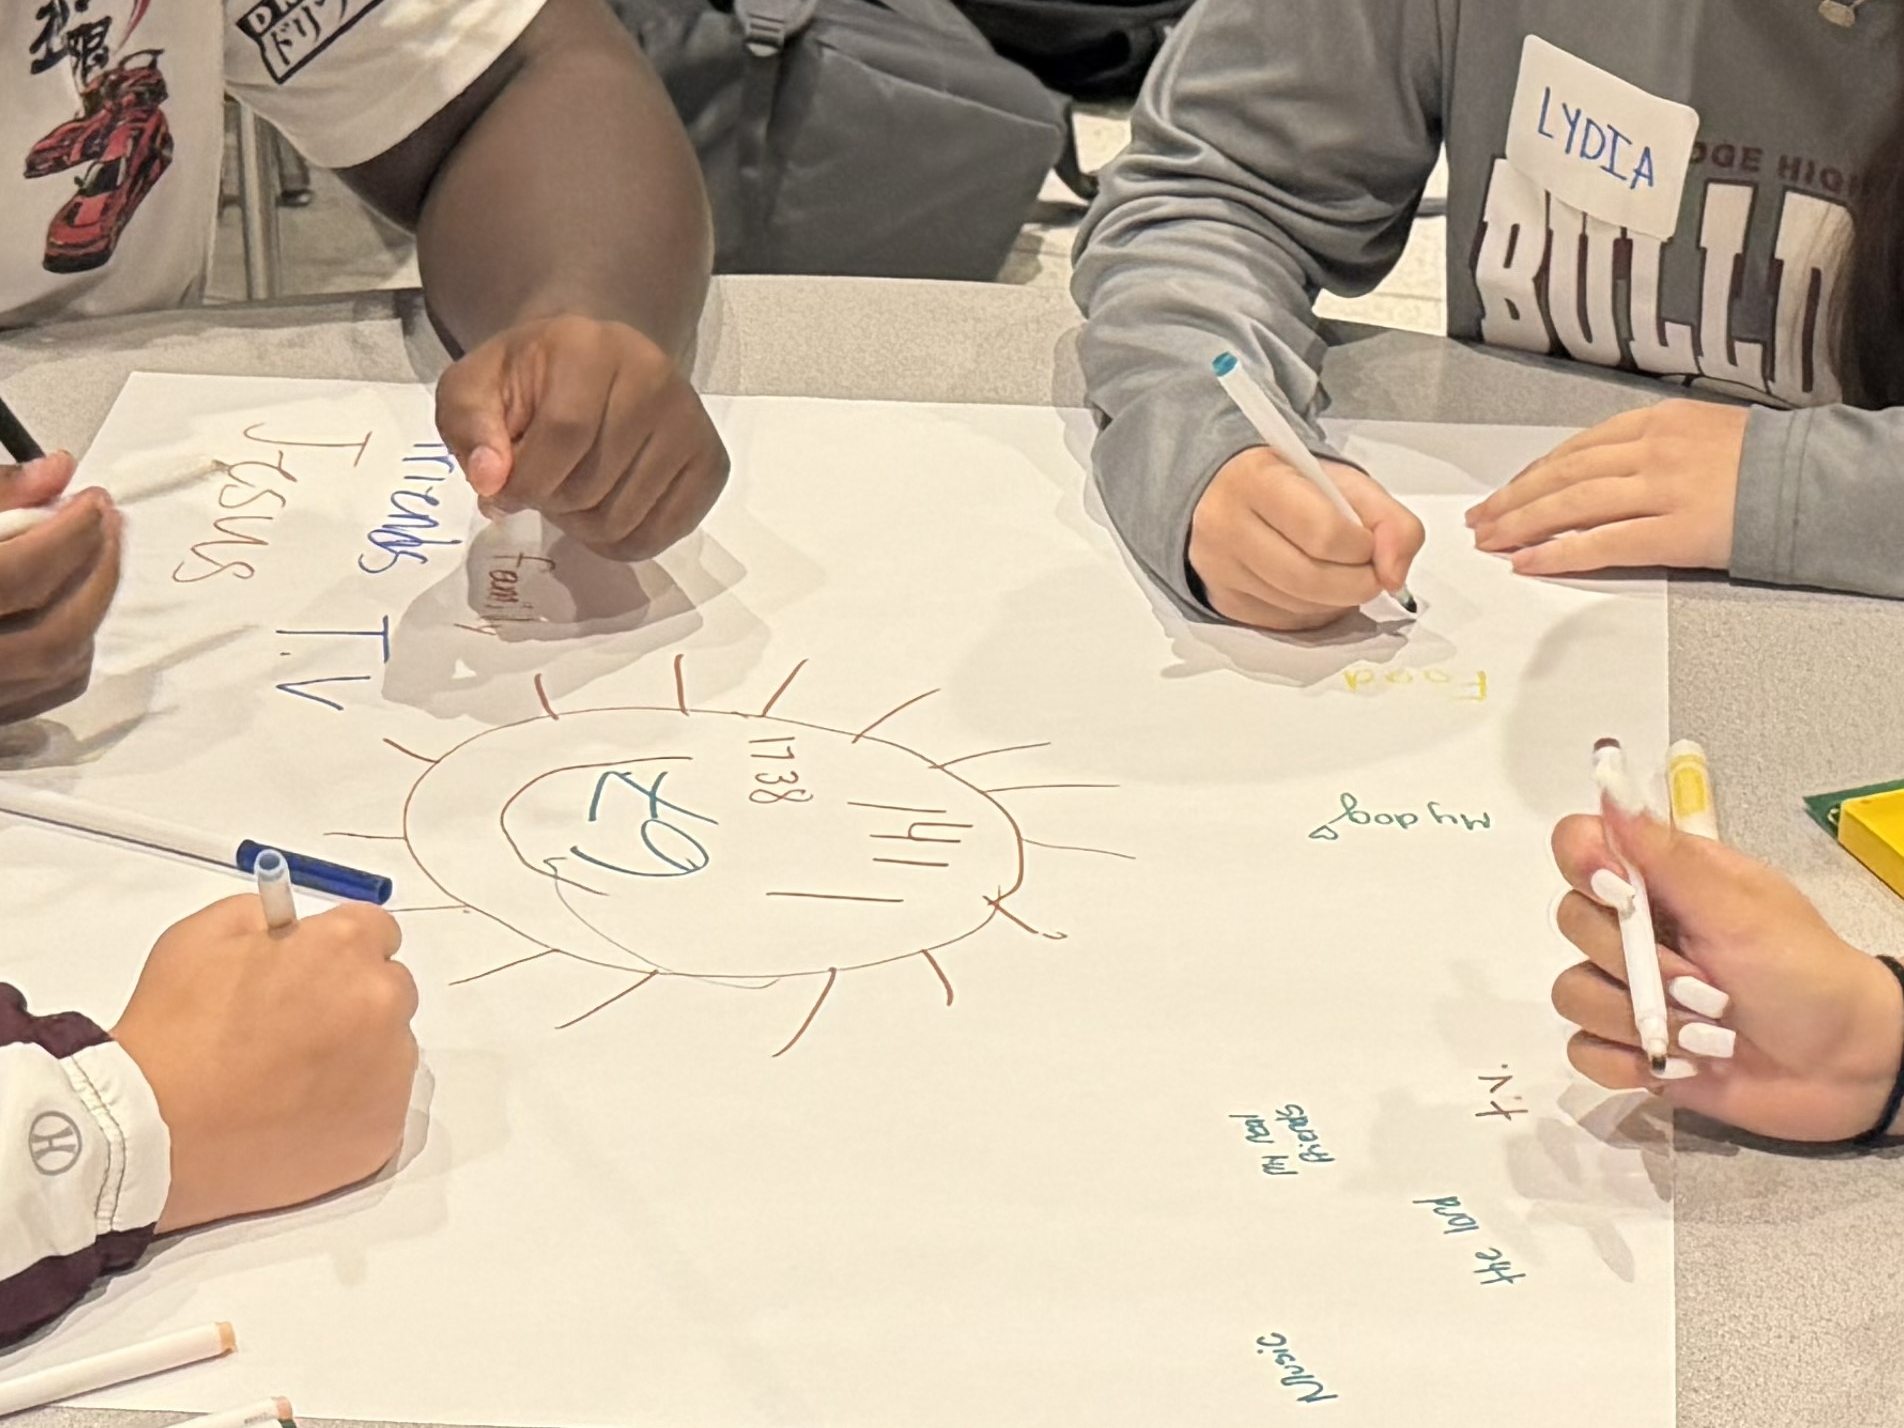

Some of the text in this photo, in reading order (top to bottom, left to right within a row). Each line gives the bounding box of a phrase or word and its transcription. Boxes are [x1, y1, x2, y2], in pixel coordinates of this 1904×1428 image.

[1537, 85, 1655, 190] LYDIA
[1690, 141, 1763, 174] DGE
[1473, 156, 1858, 405] BULLD
[171, 423, 373, 584] Jesus
[1343, 669, 1487, 702] Food
[748, 735, 814, 805] 1738
[1338, 792, 1492, 832] My dog
[1256, 1332, 1339, 1404] Music
